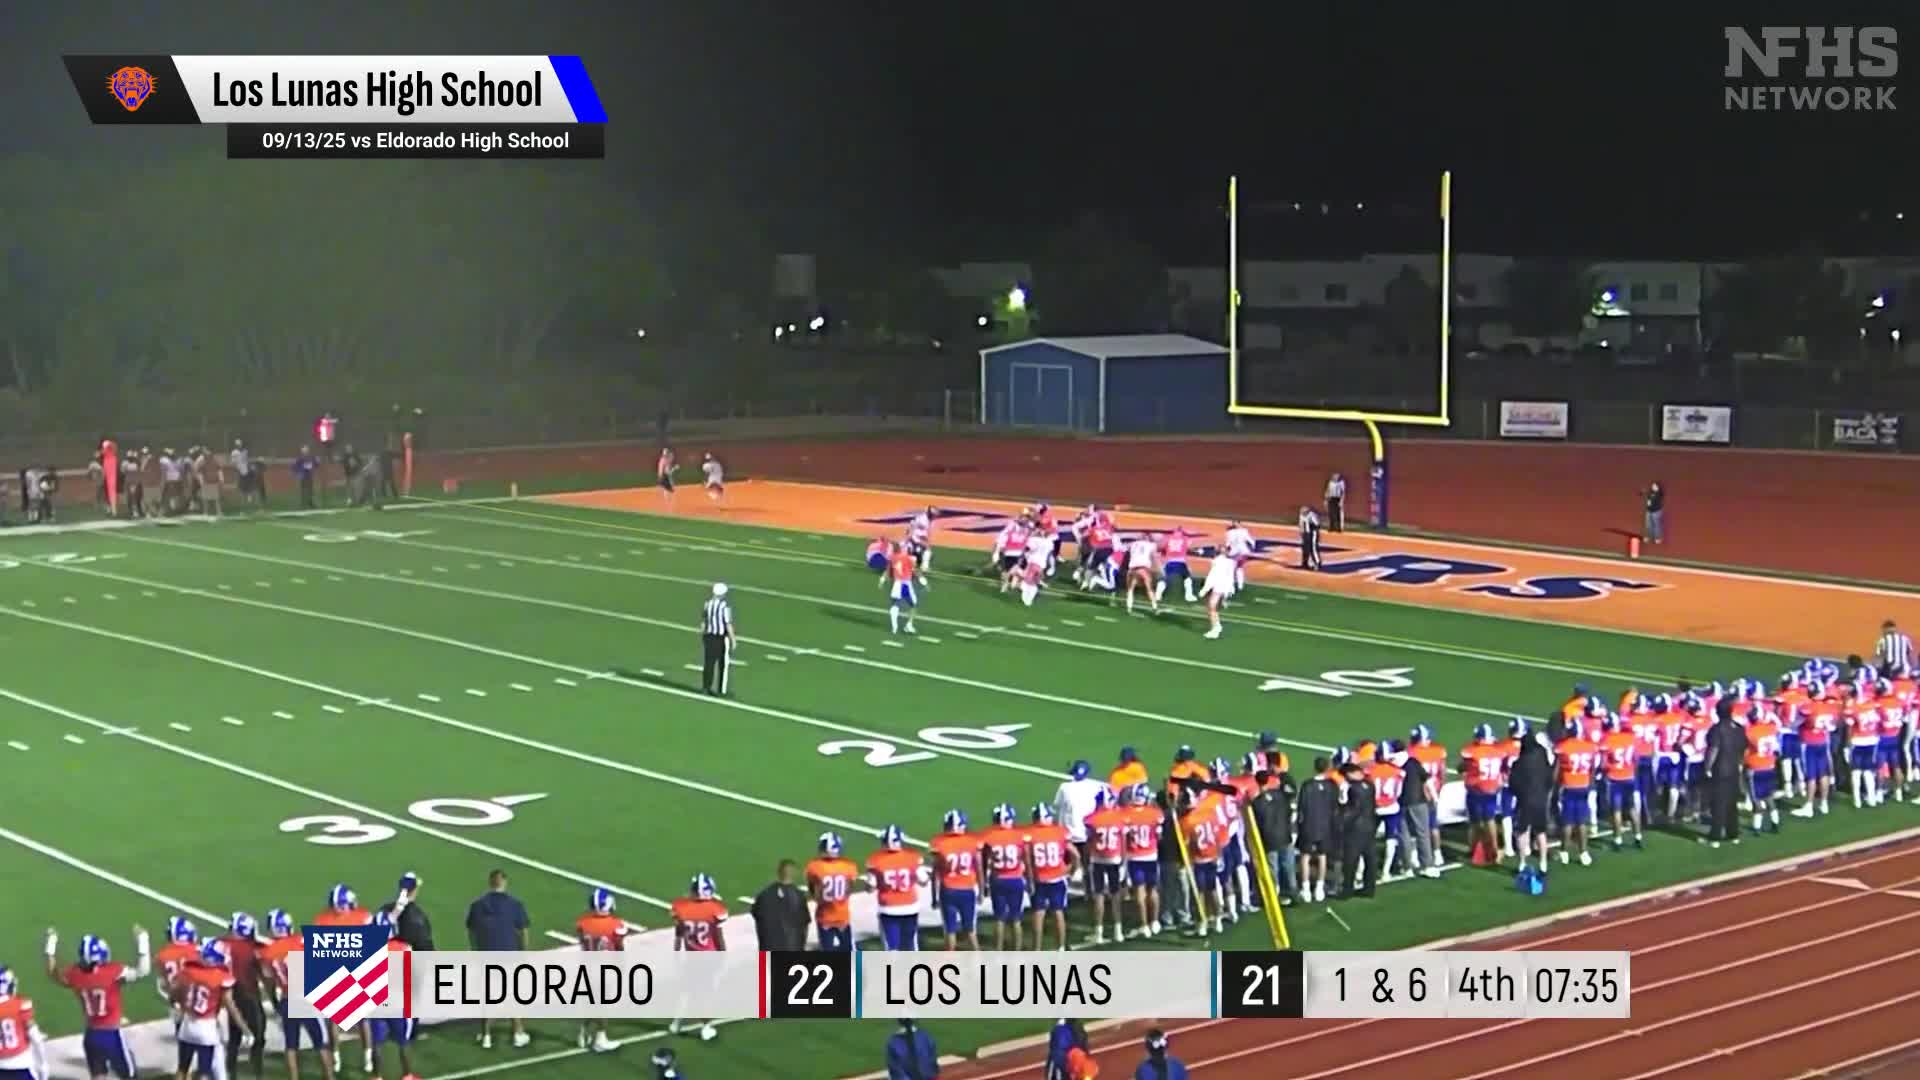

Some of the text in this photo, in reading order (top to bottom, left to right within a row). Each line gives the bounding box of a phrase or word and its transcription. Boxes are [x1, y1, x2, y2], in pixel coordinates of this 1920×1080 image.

[817, 725, 1017, 767] 20
[279, 796, 516, 846] 30
[822, 874, 846, 900] 20
[883, 868, 912, 892] 53
[82, 989, 108, 1017] 17
